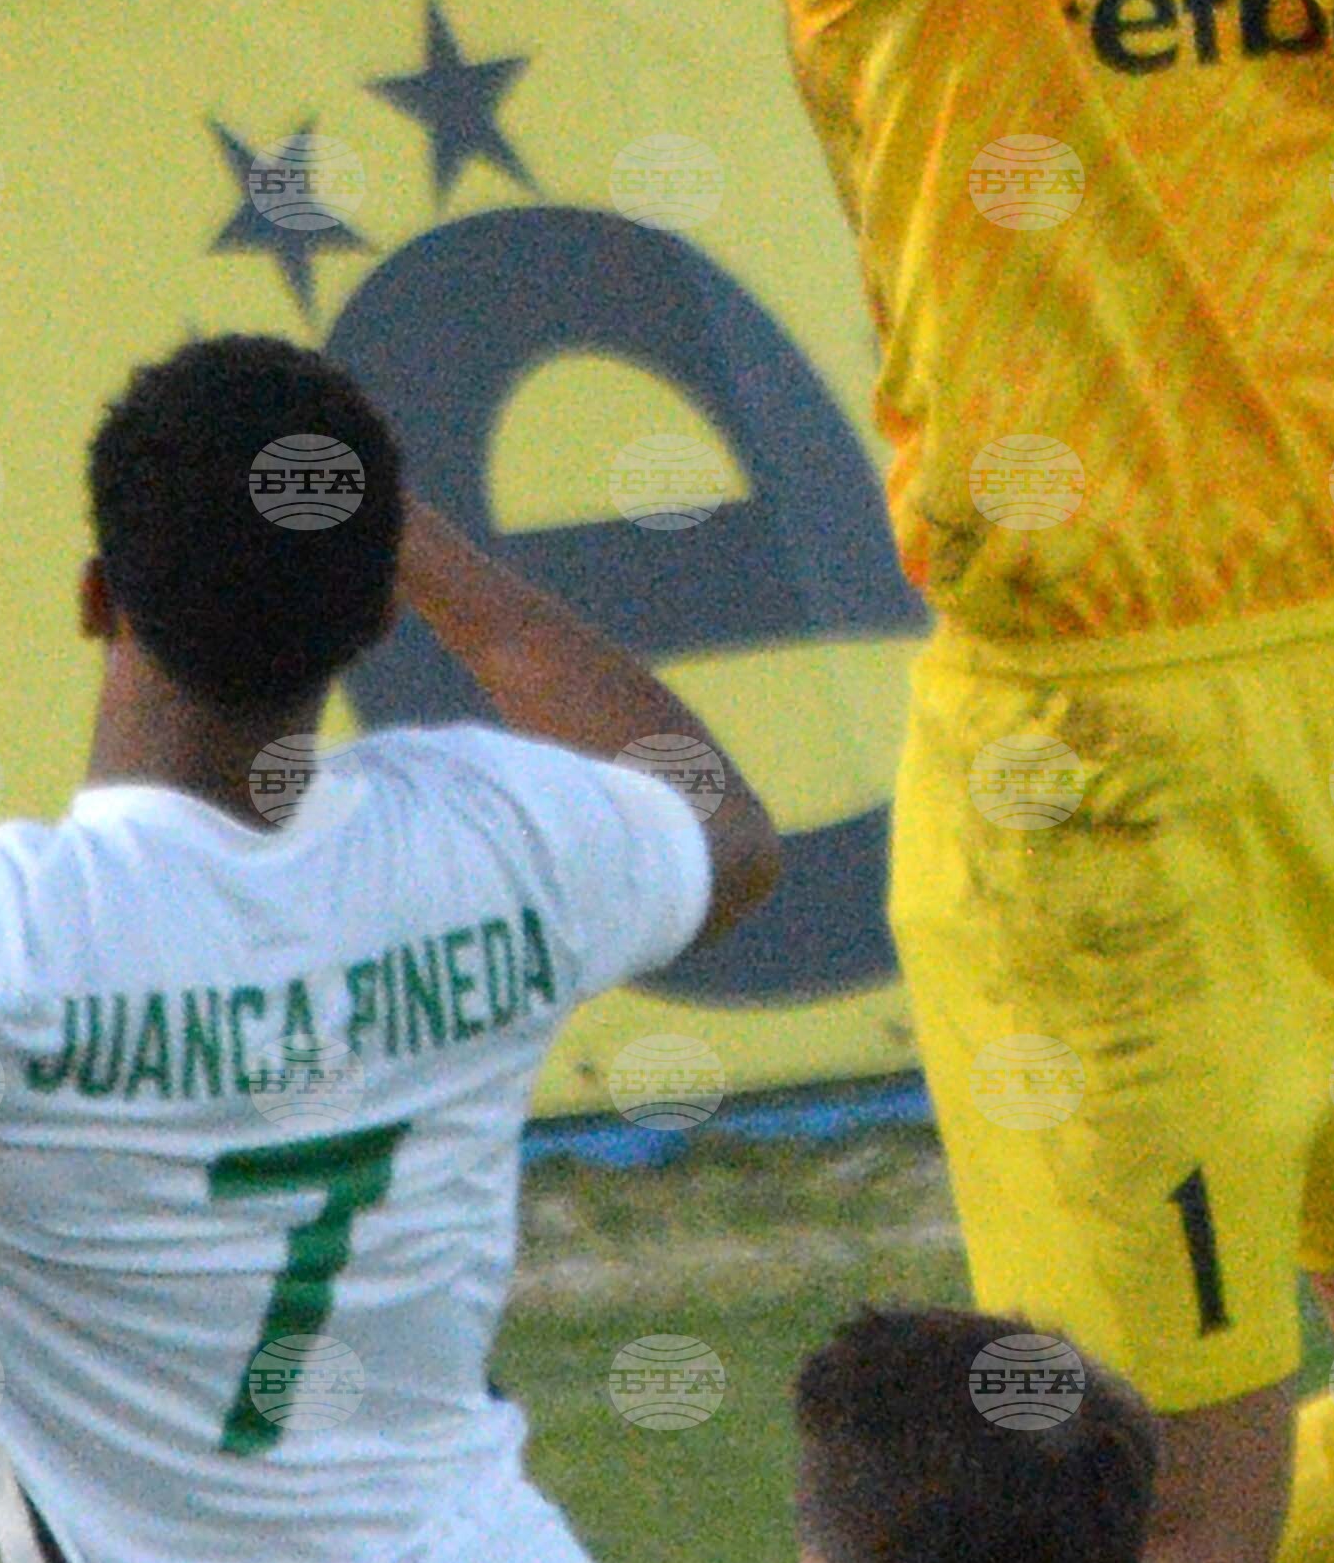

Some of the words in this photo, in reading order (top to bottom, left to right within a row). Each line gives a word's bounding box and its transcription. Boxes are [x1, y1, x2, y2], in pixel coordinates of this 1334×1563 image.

[22, 976, 322, 1101] JUANCA
[345, 906, 557, 1058] PINEDA
[207, 1120, 413, 1456] 7
[1168, 1166, 1233, 1339] 1
